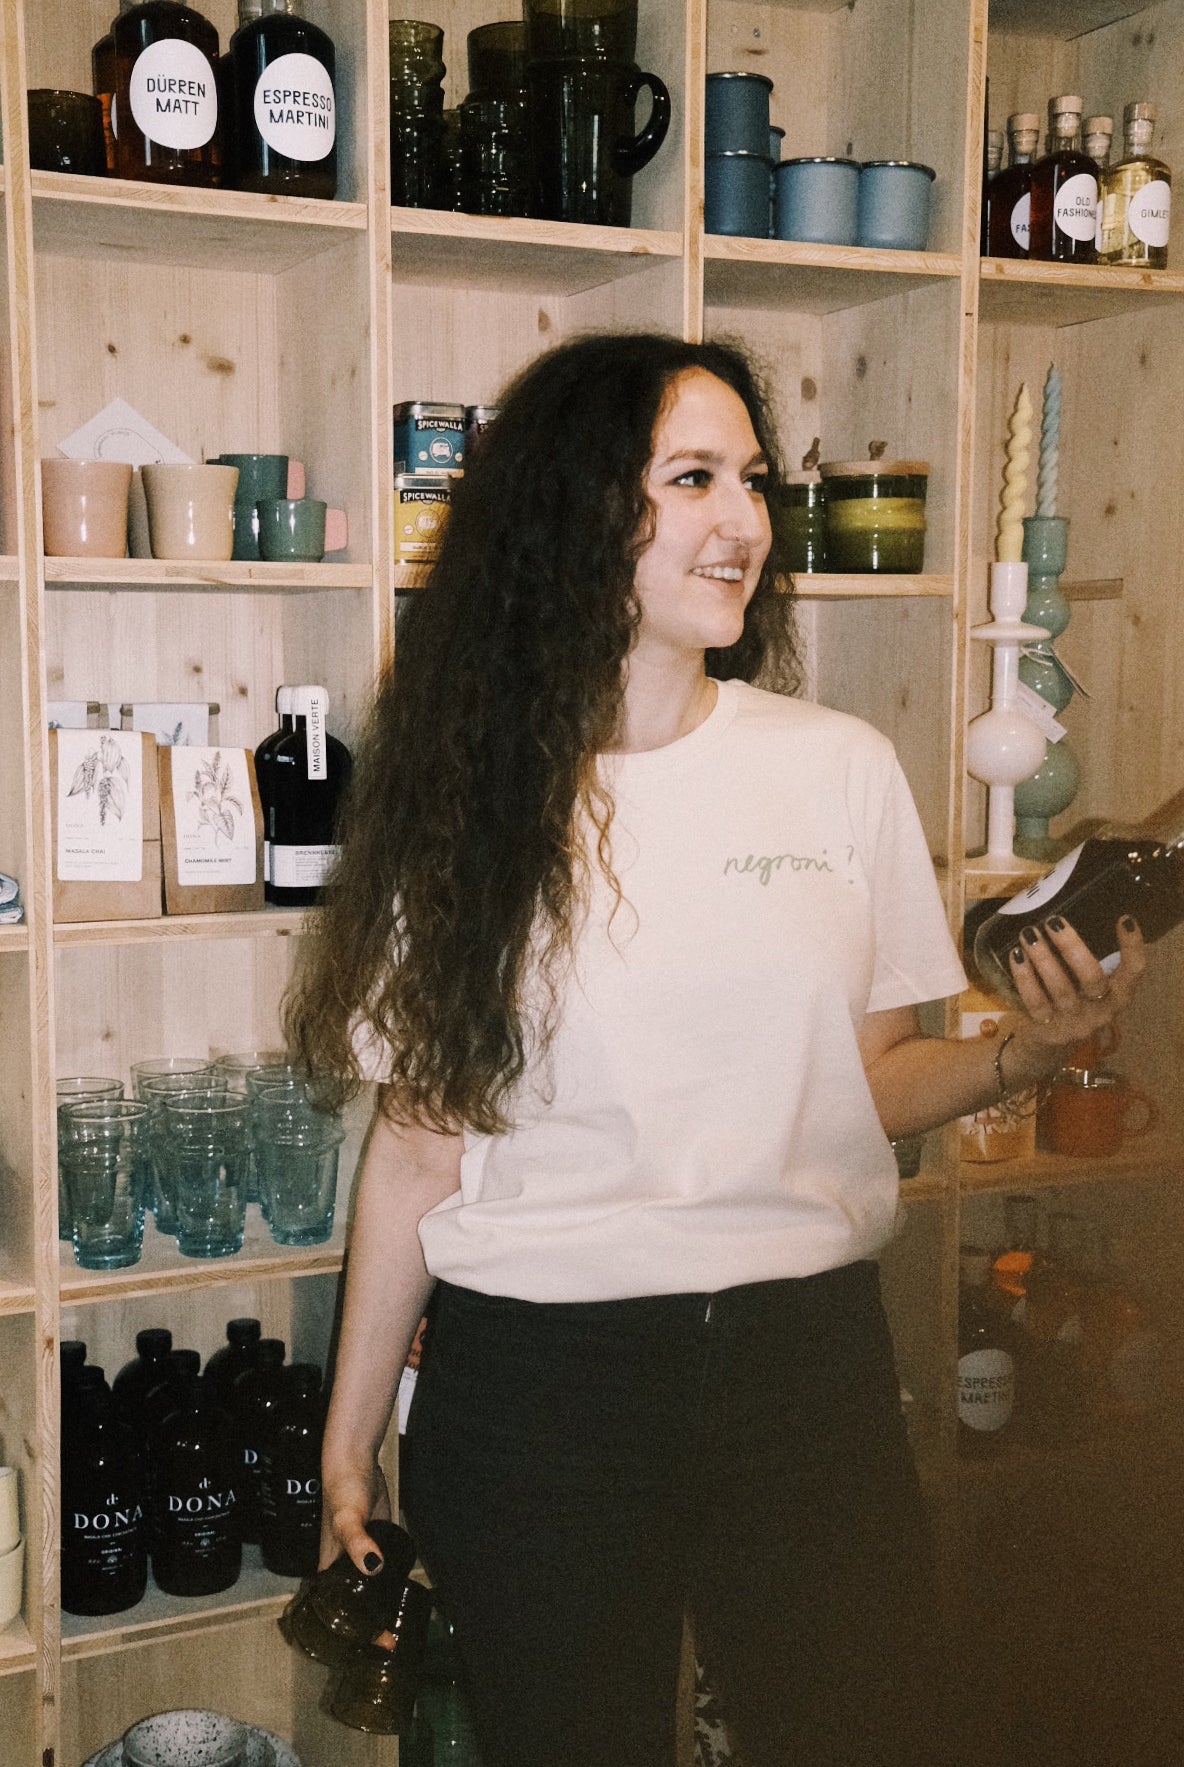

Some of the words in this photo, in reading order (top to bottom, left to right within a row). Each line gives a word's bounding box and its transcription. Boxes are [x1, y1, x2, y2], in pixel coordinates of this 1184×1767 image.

[147, 74, 206, 98] DÜRREN
[156, 98, 200, 115] MATT
[263, 90, 332, 111] ESPRESSO
[269, 110, 329, 130] MARTINI
[1075, 196, 1091, 206] OLD
[417, 420, 463, 431] SPICEWALLA
[311, 699, 320, 731] VERTE
[312, 734, 321, 772] MAISON
[724, 848, 833, 886] negroni
[169, 1489, 236, 1512] DONA
[74, 1504, 143, 1530] DONA
